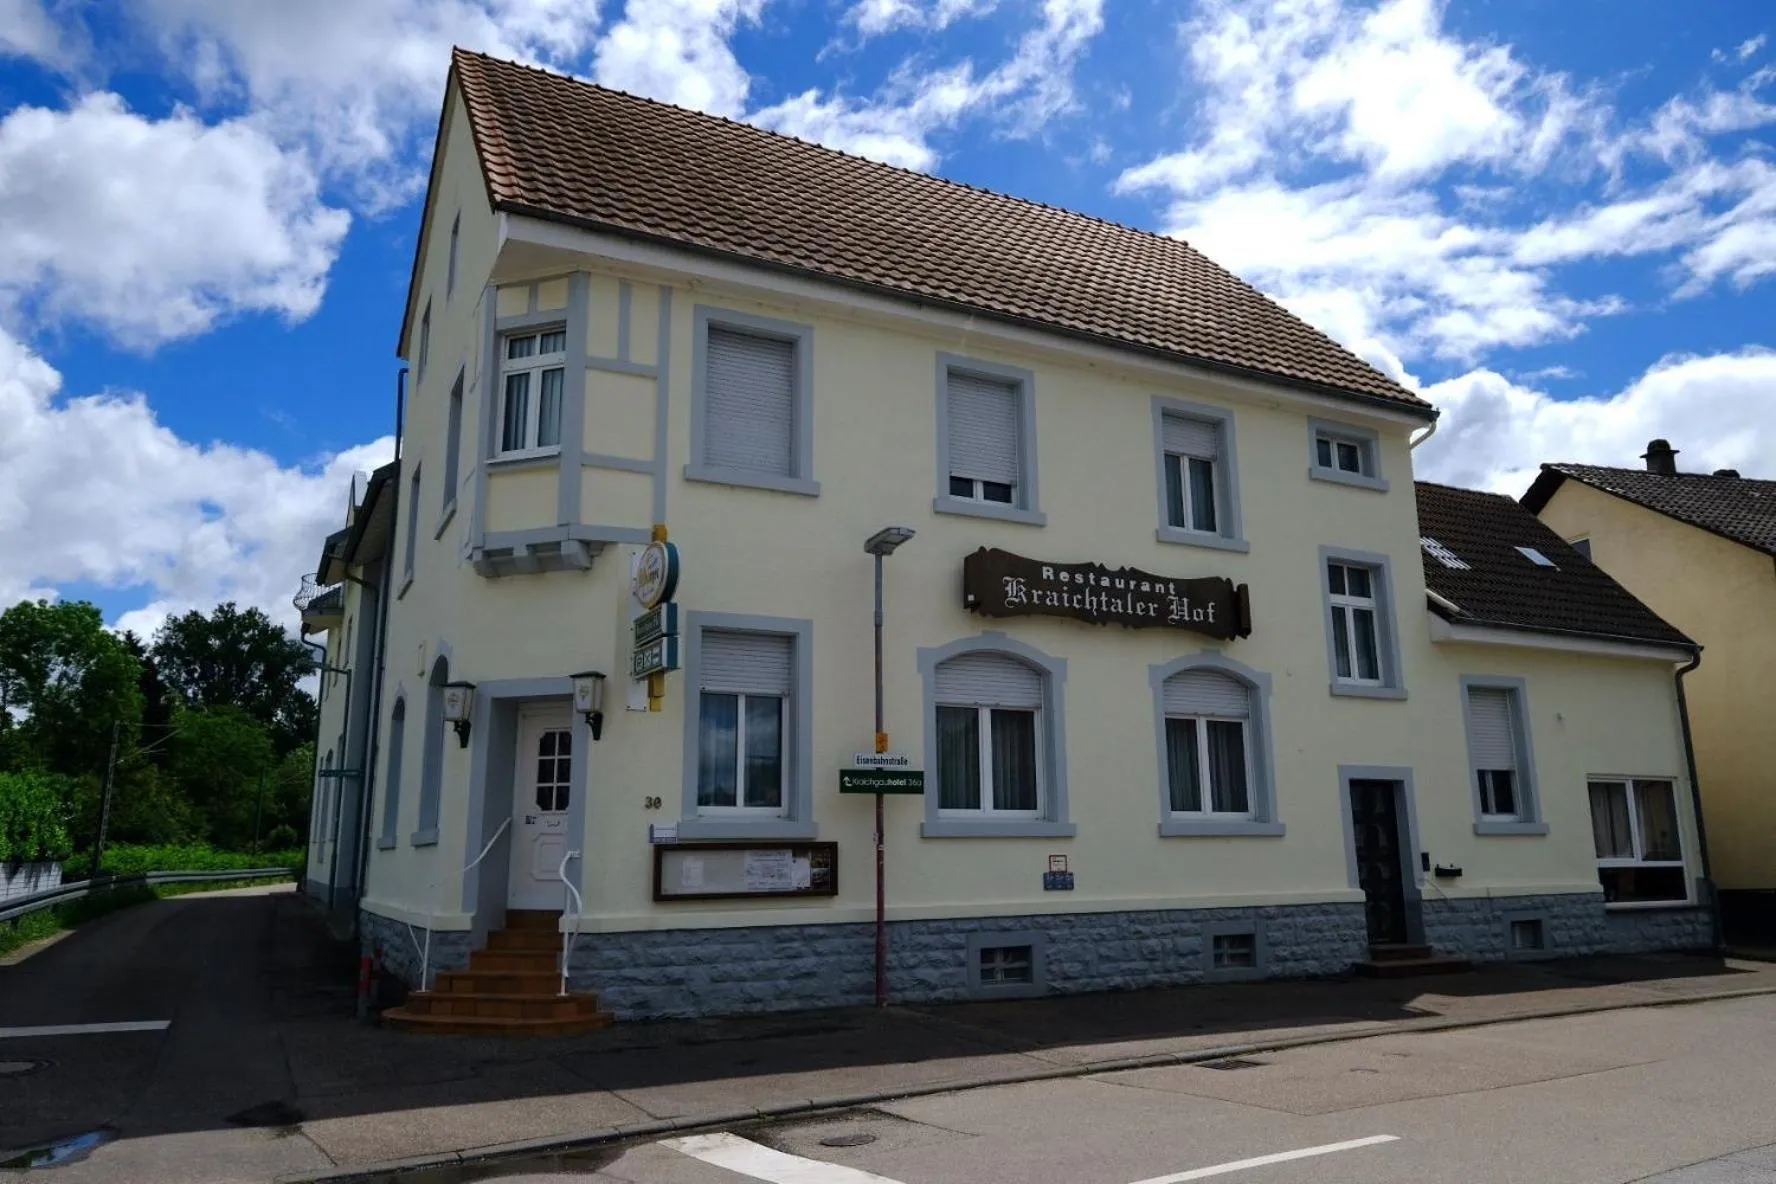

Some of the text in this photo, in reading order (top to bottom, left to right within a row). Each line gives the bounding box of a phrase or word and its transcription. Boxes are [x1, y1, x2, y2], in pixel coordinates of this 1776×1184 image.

[1042, 566, 1175, 594] Restaurant
[1003, 576, 1216, 624] Kraichtaler Hof
[856, 755, 908, 766] Eisenbahnstraße
[645, 796, 662, 809] 30
